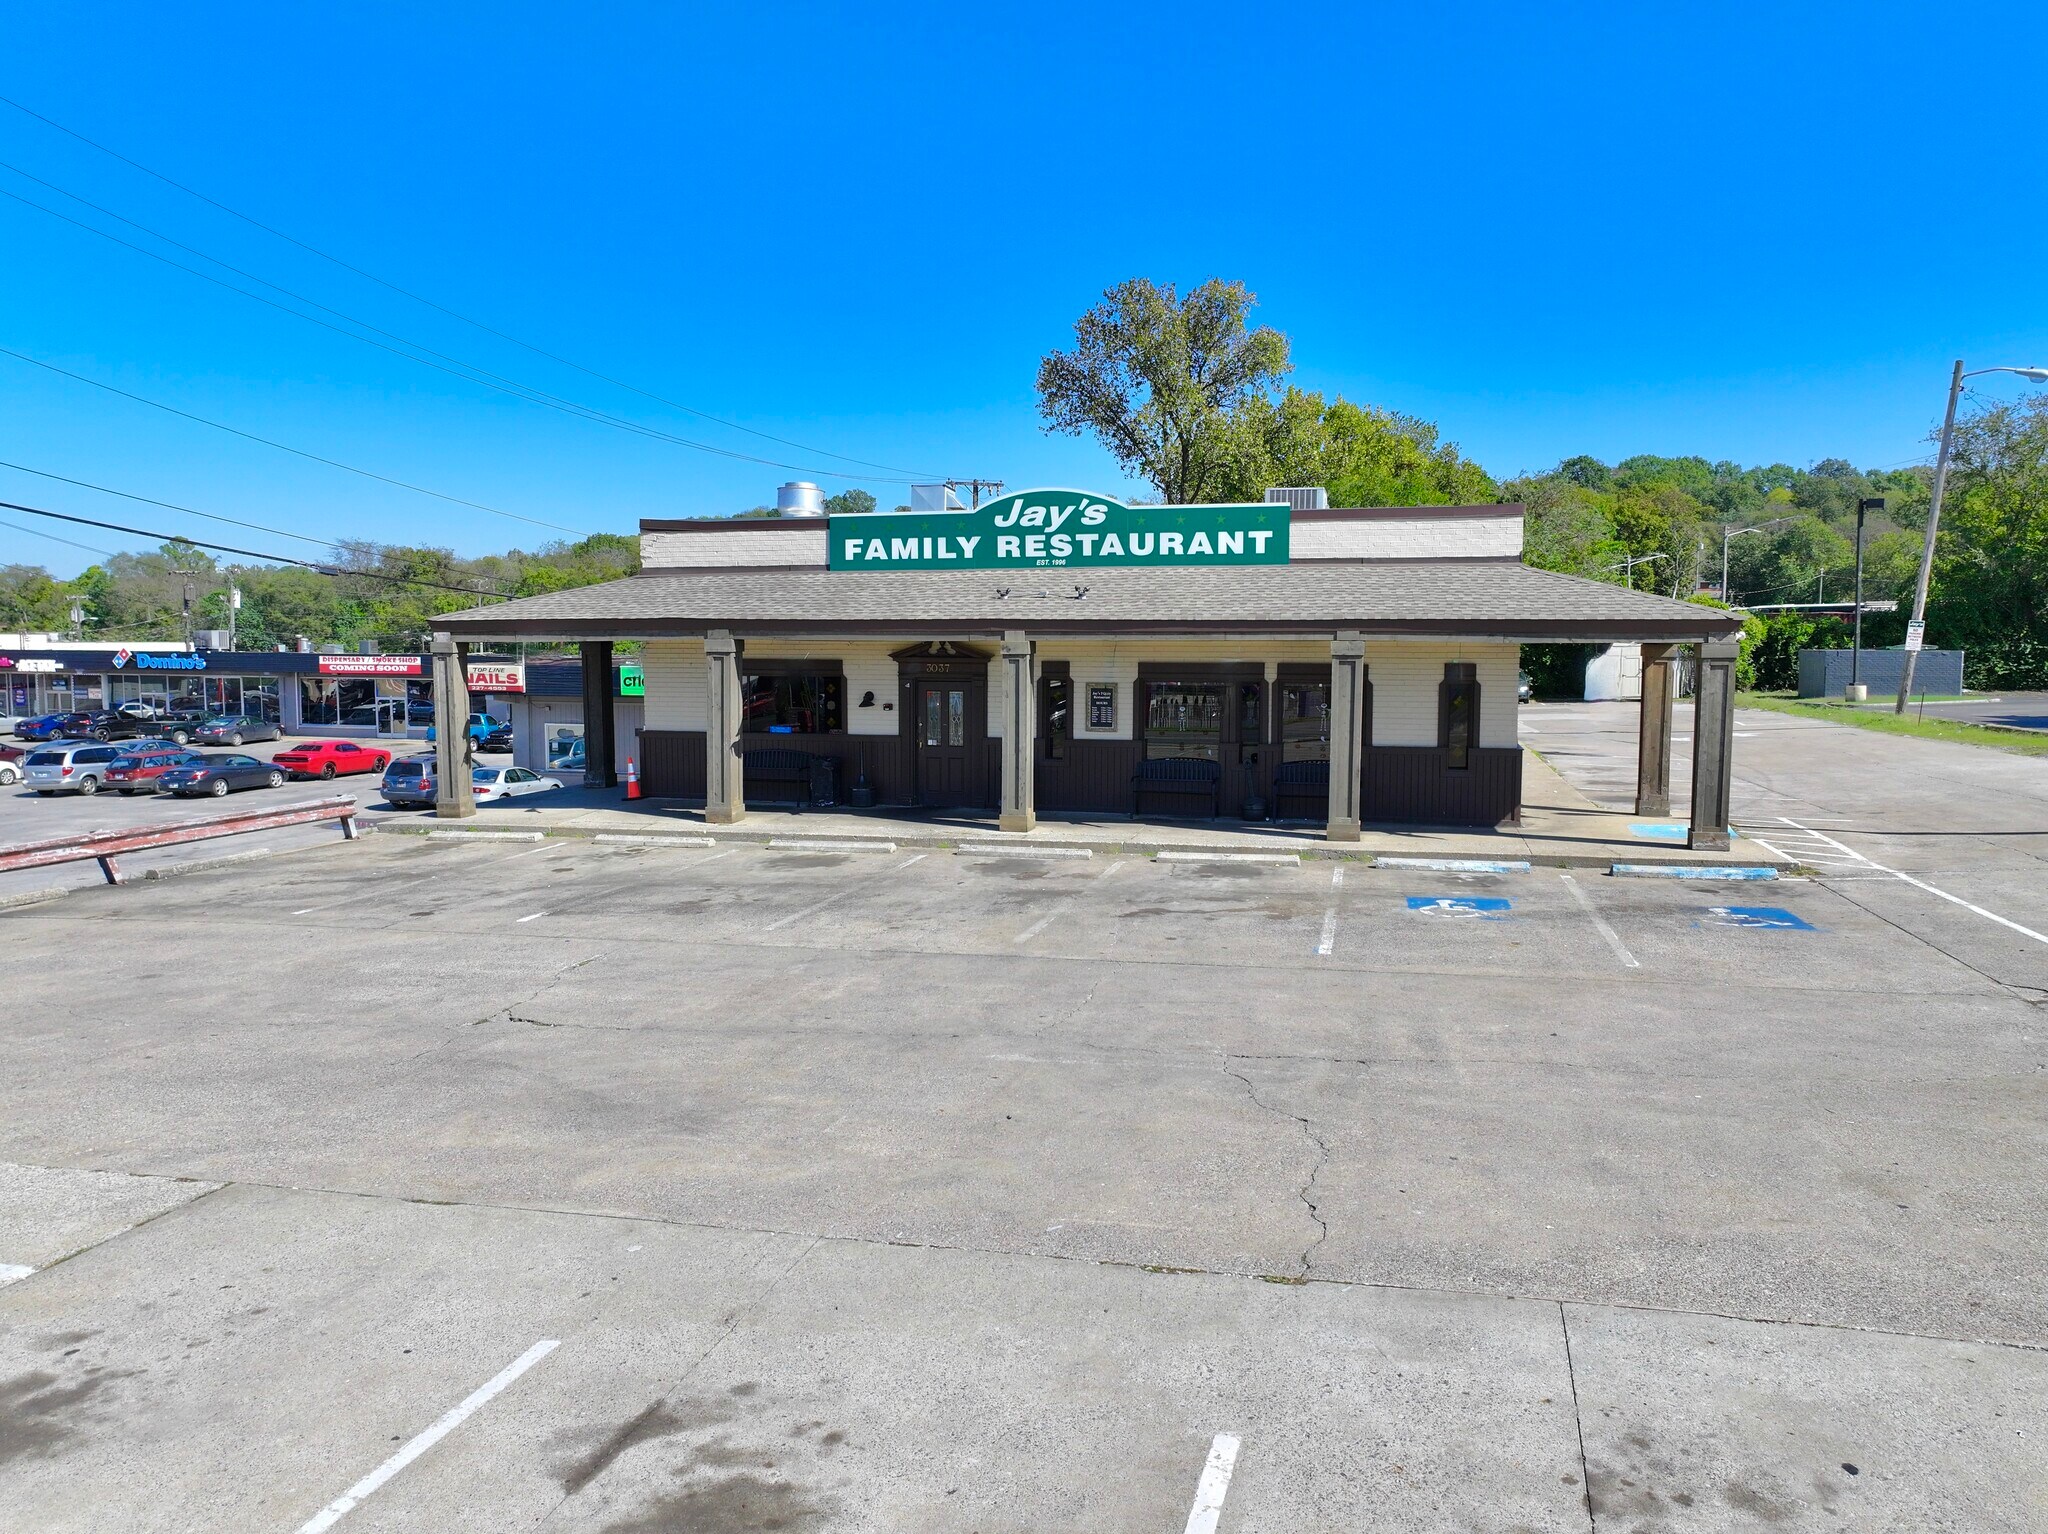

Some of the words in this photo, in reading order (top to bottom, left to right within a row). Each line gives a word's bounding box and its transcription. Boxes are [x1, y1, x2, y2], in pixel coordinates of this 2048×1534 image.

[994, 498, 1107, 533] Jay's
[845, 536, 981, 561] FAMILY
[997, 531, 1273, 557] RESTAURANT
[136, 653, 206, 670] Domino's
[372, 656, 397, 664] SMOKE
[329, 664, 375, 672] COMING
[376, 664, 408, 672] SOON
[926, 663, 949, 672] 3037
